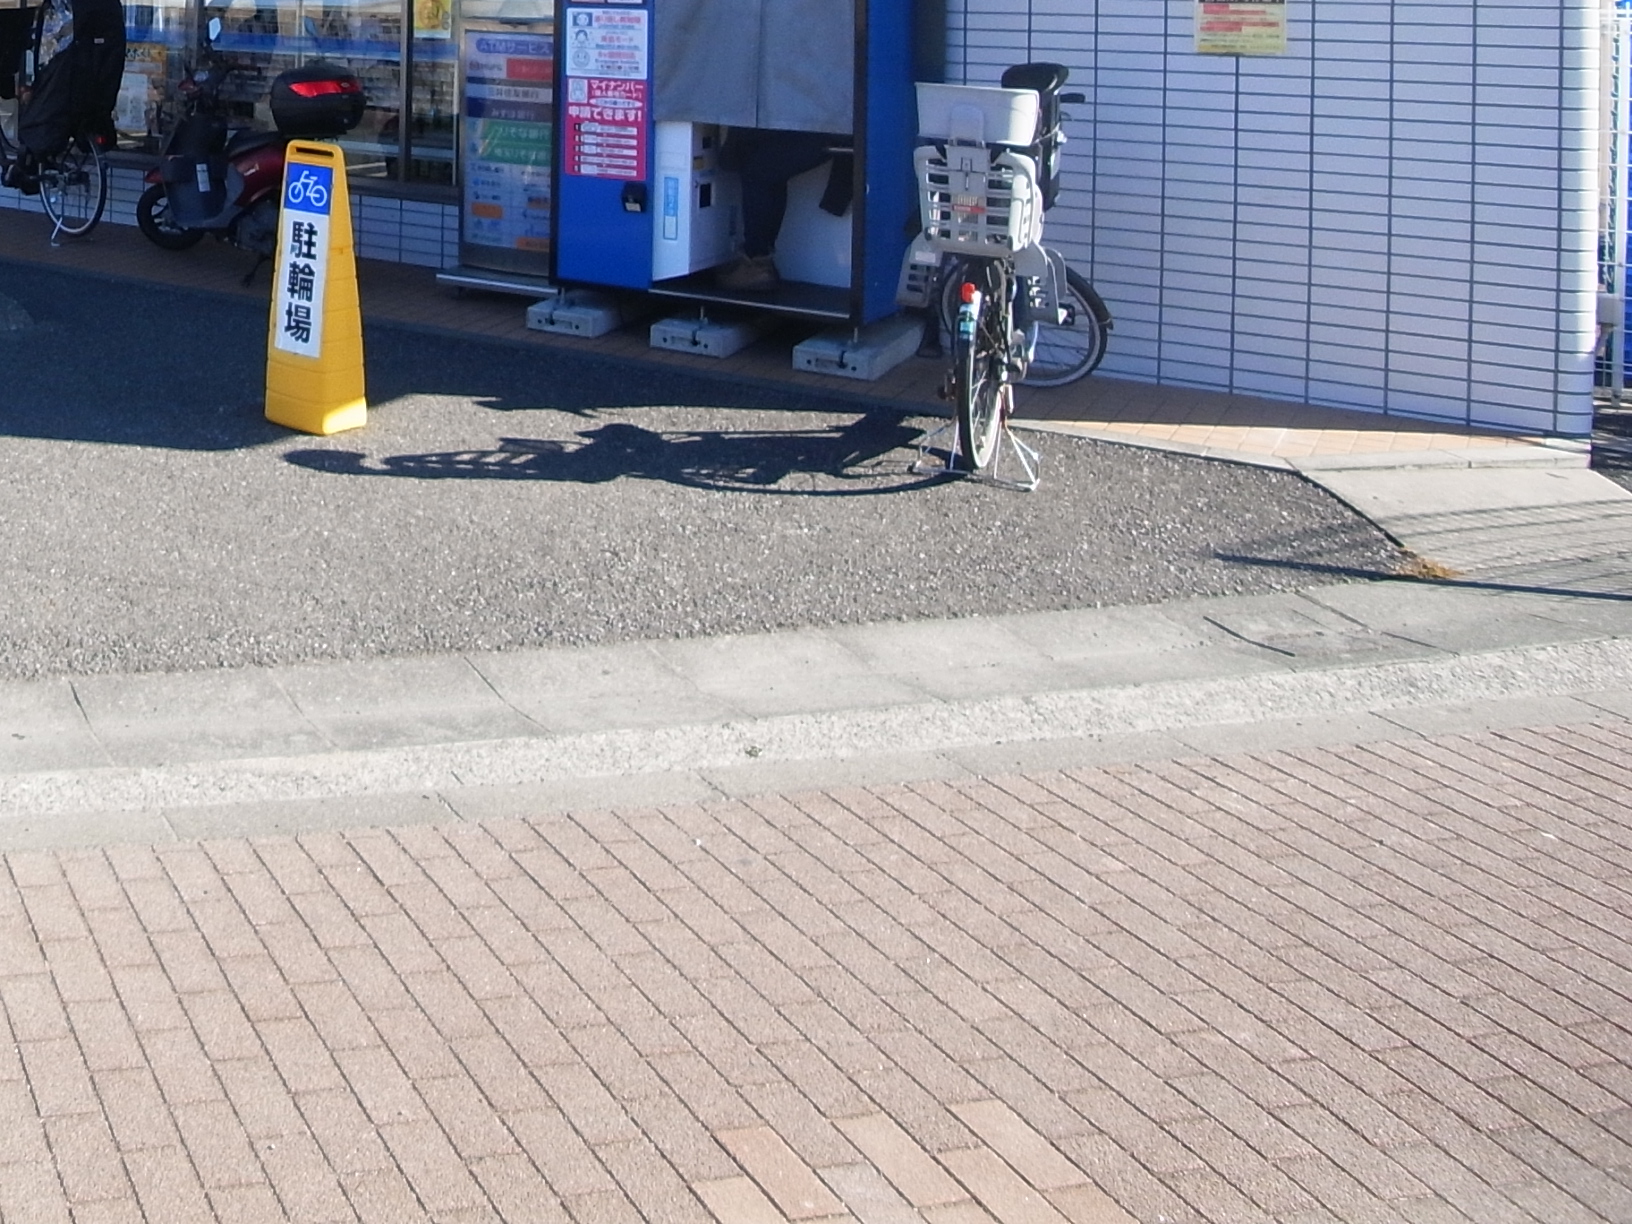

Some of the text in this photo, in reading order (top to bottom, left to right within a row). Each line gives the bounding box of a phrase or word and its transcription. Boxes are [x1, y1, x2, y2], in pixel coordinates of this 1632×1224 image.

[480, 39, 551, 54] ATMサービス
[590, 79, 644, 91] マイナンバー
[283, 220, 319, 344] 駐輪場
